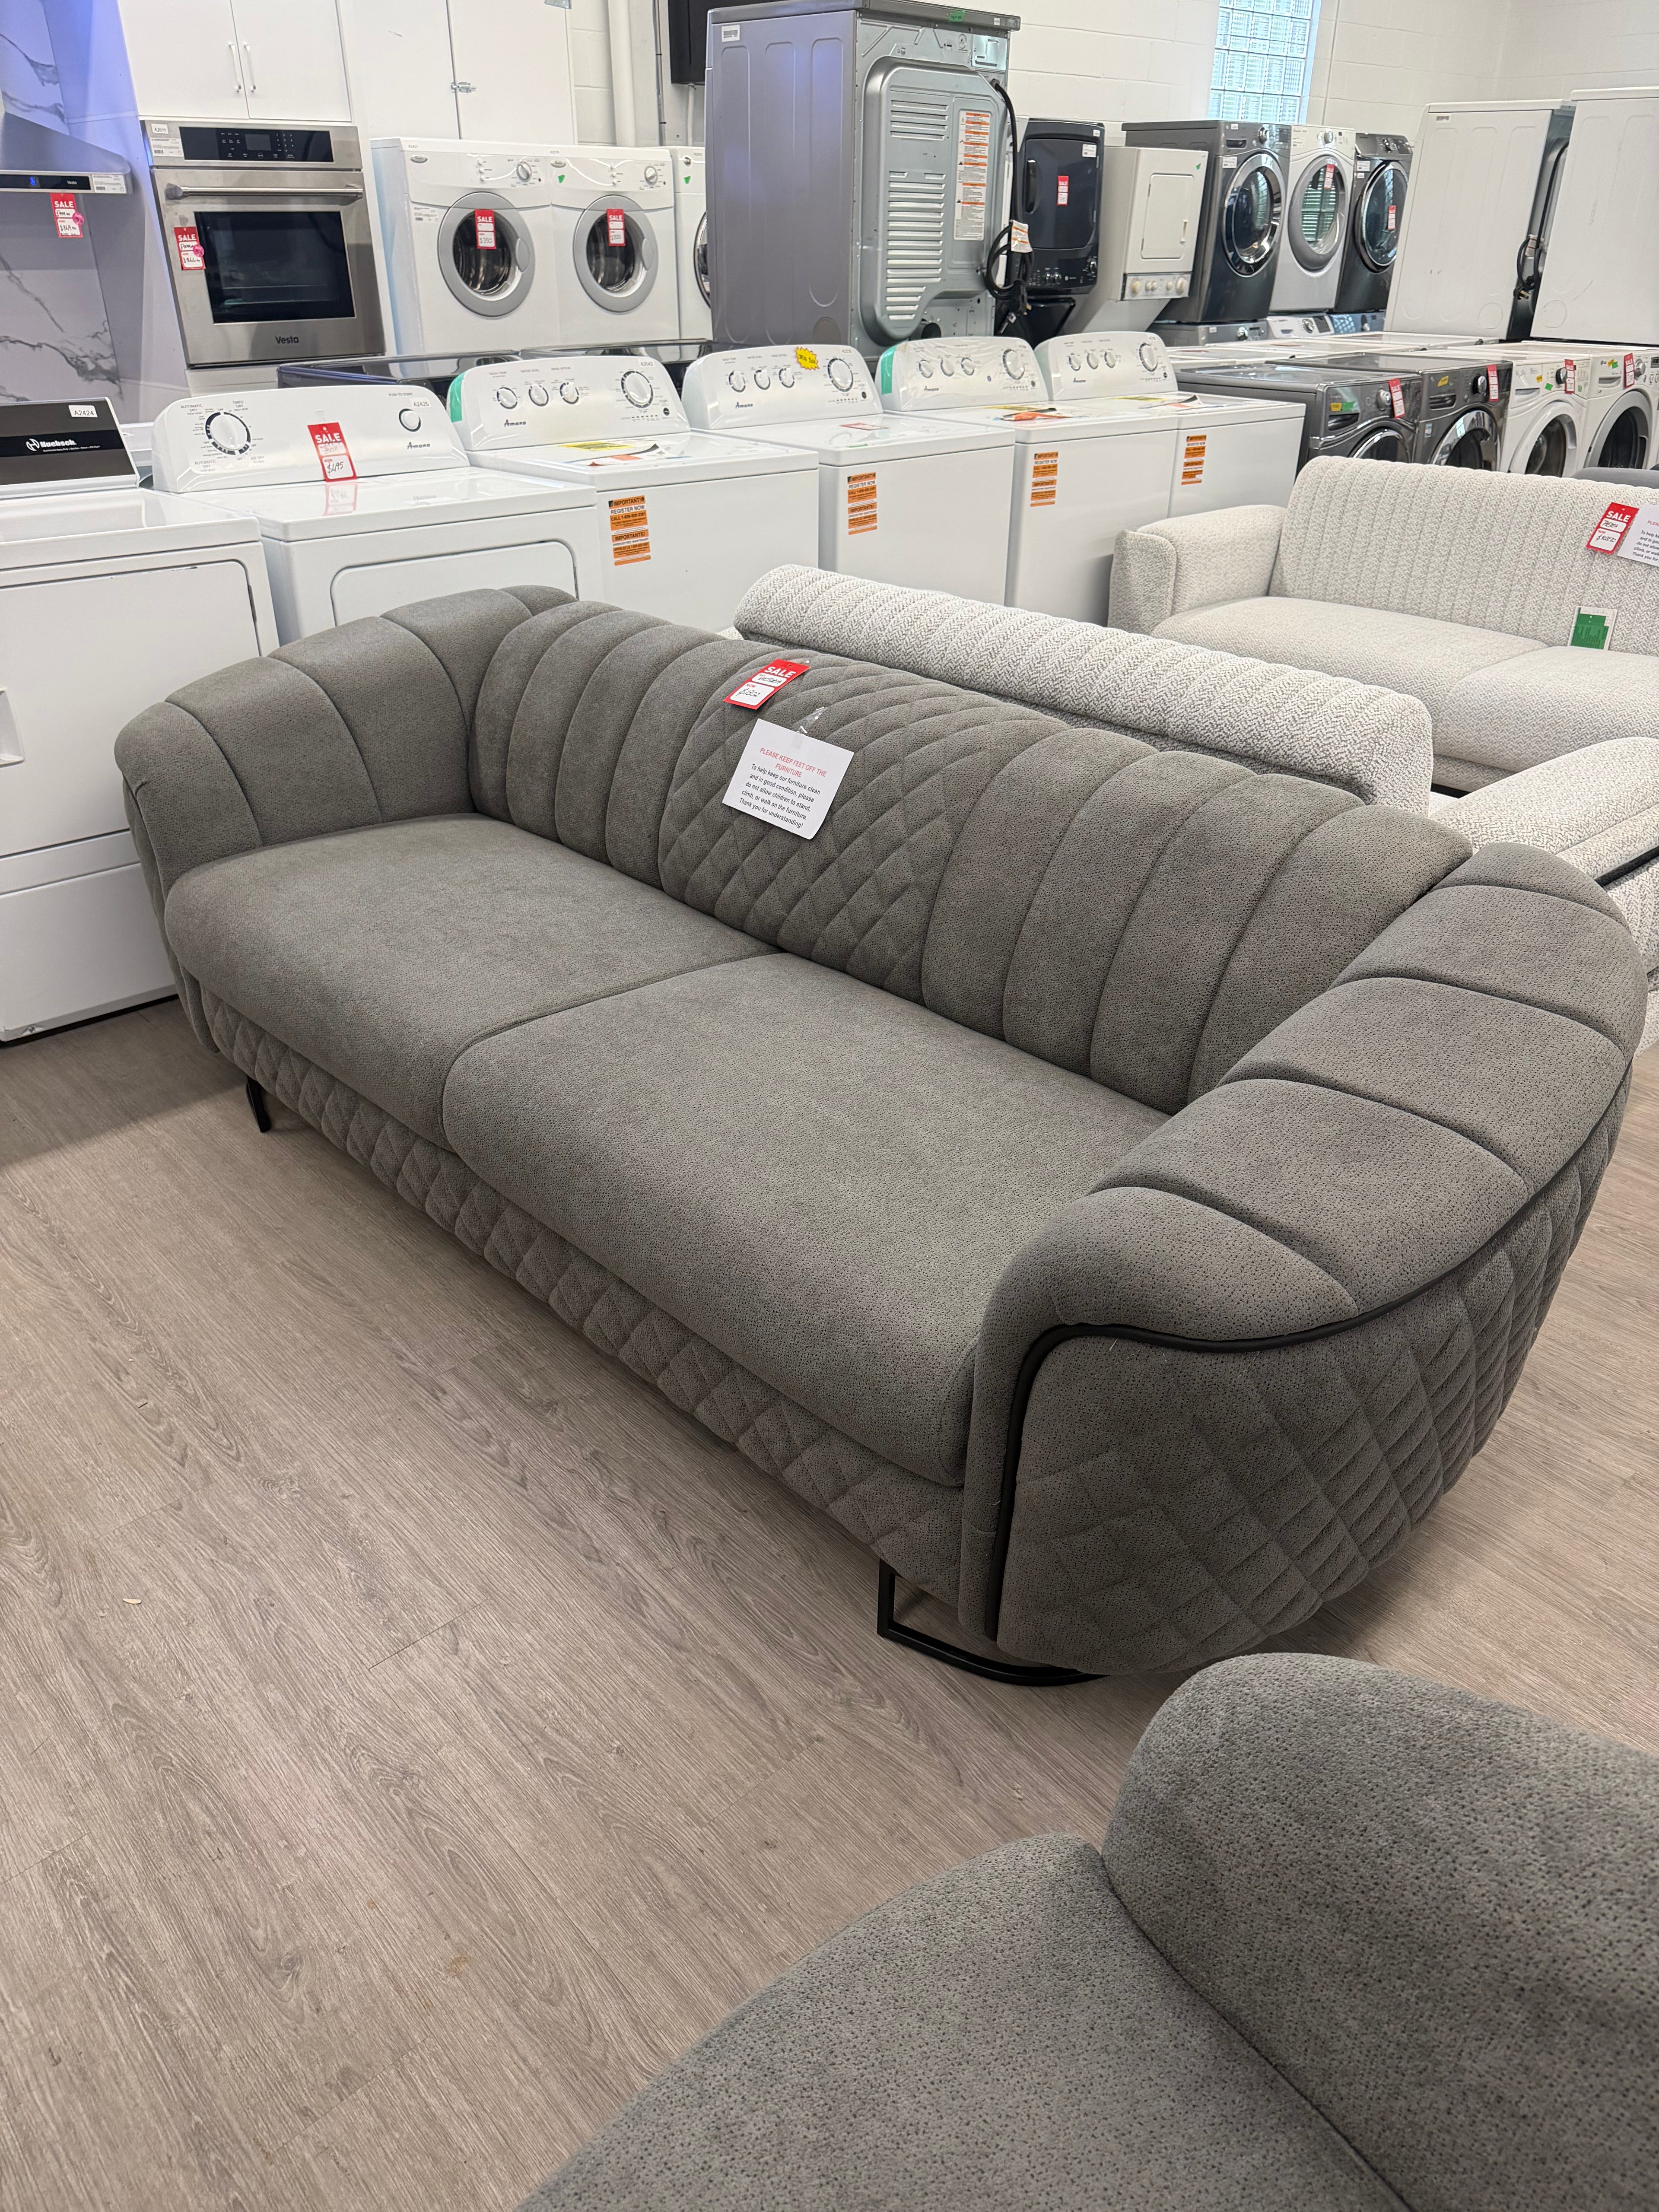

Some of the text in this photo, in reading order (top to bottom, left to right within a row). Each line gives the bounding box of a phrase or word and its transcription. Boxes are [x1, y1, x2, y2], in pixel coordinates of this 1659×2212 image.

[275, 336, 299, 344] Vesta
[315, 433, 342, 443] SALE
[327, 461, 344, 477] $495
[610, 506, 634, 515] REGISTER
[1606, 511, 1631, 522] SALE
[764, 666, 796, 678] SALE
[760, 748, 779, 759] PLEASE
[779, 755, 793, 764] KEEP
[793, 760, 805, 769] FEET
[775, 763, 803, 778] FURNITURE
[768, 770, 779, 779] keep
[787, 778, 807, 789] furniture
[807, 786, 820, 795] clean
[776, 785, 797, 797] condition,
[798, 793, 814, 802] please
[742, 790, 754, 799] climb,
[785, 807, 807, 820] furniture.
[772, 793, 790, 803] children
[796, 802, 810, 811] stand,
[739, 798, 752, 807] Thank
[769, 810, 803, 829] understanding!
